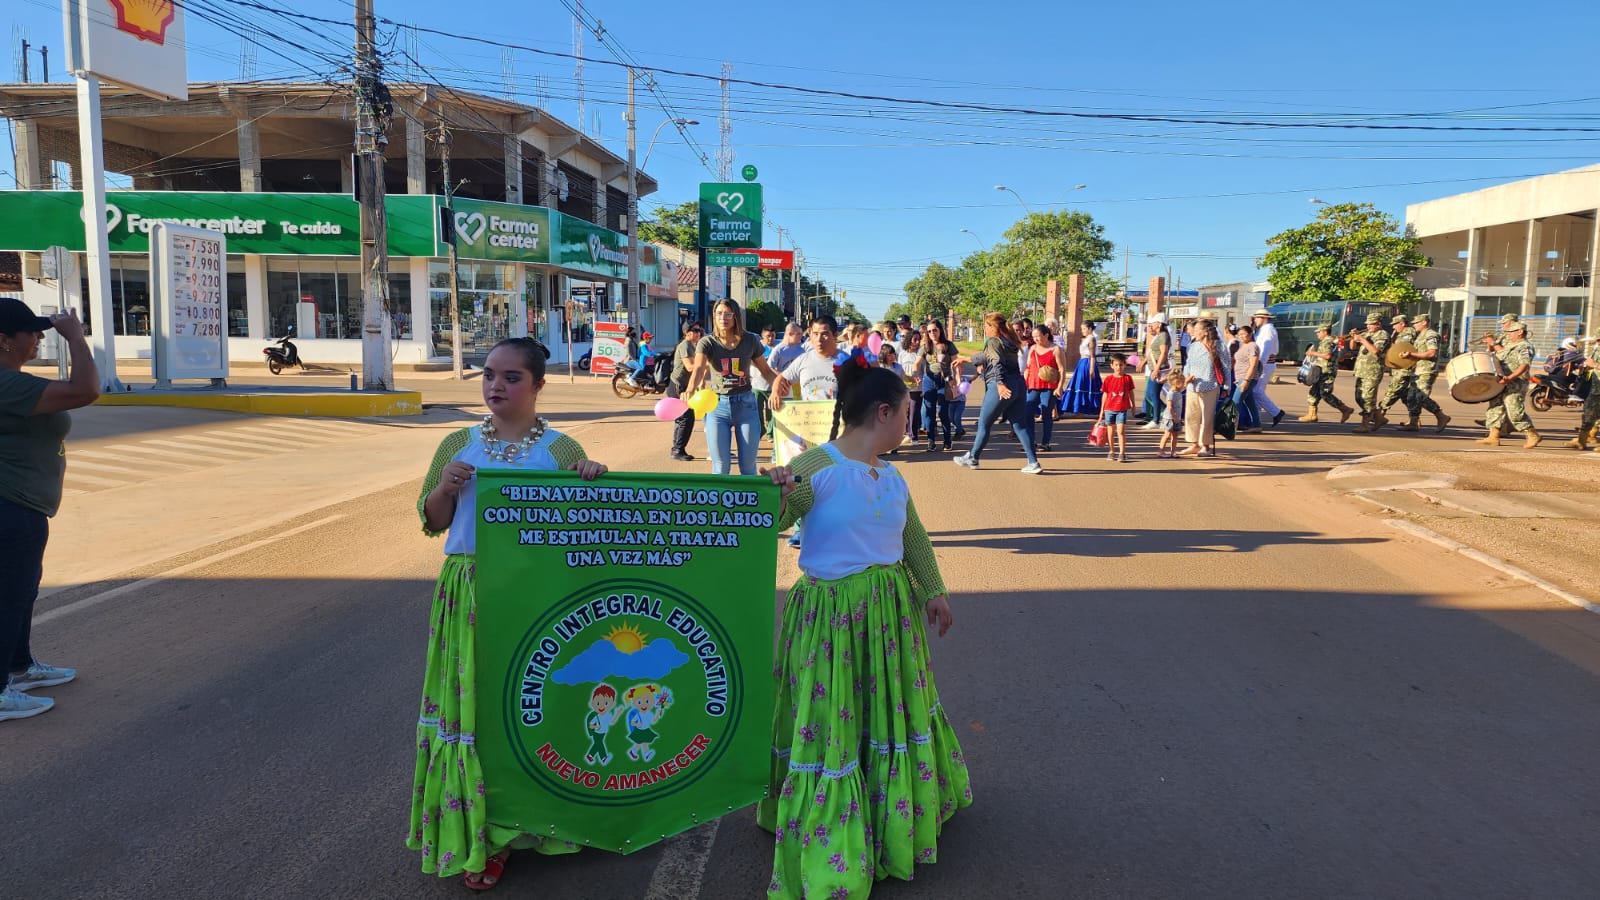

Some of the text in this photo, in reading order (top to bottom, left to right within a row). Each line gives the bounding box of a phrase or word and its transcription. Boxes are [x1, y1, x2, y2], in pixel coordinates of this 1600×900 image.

[280, 220, 298, 234] Te
[300, 221, 341, 234] cuida
[489, 216, 539, 234] Farma
[710, 219, 752, 230] Farma
[488, 231, 539, 249] center
[710, 231, 752, 241] center
[192, 240, 219, 255] 7.530
[192, 256, 219, 272] 7.990
[192, 273, 219, 288] 9.220
[192, 289, 219, 304] 9.275
[192, 324, 220, 336] 7.280
[500, 486, 758, 508] “BIENAVENTURADOS LOS QUE
[483, 507, 774, 528] CON UNA SONRISA EN LOS LABIOS
[519, 529, 739, 547] ME ESTIMULAN A TRATAR
[566, 548, 692, 567] UNA VEZ MÁS”
[520, 594, 728, 726] CENTRO INTEGRAL EDUCATIVO
[535, 733, 712, 791] NUEVO AMANECER
